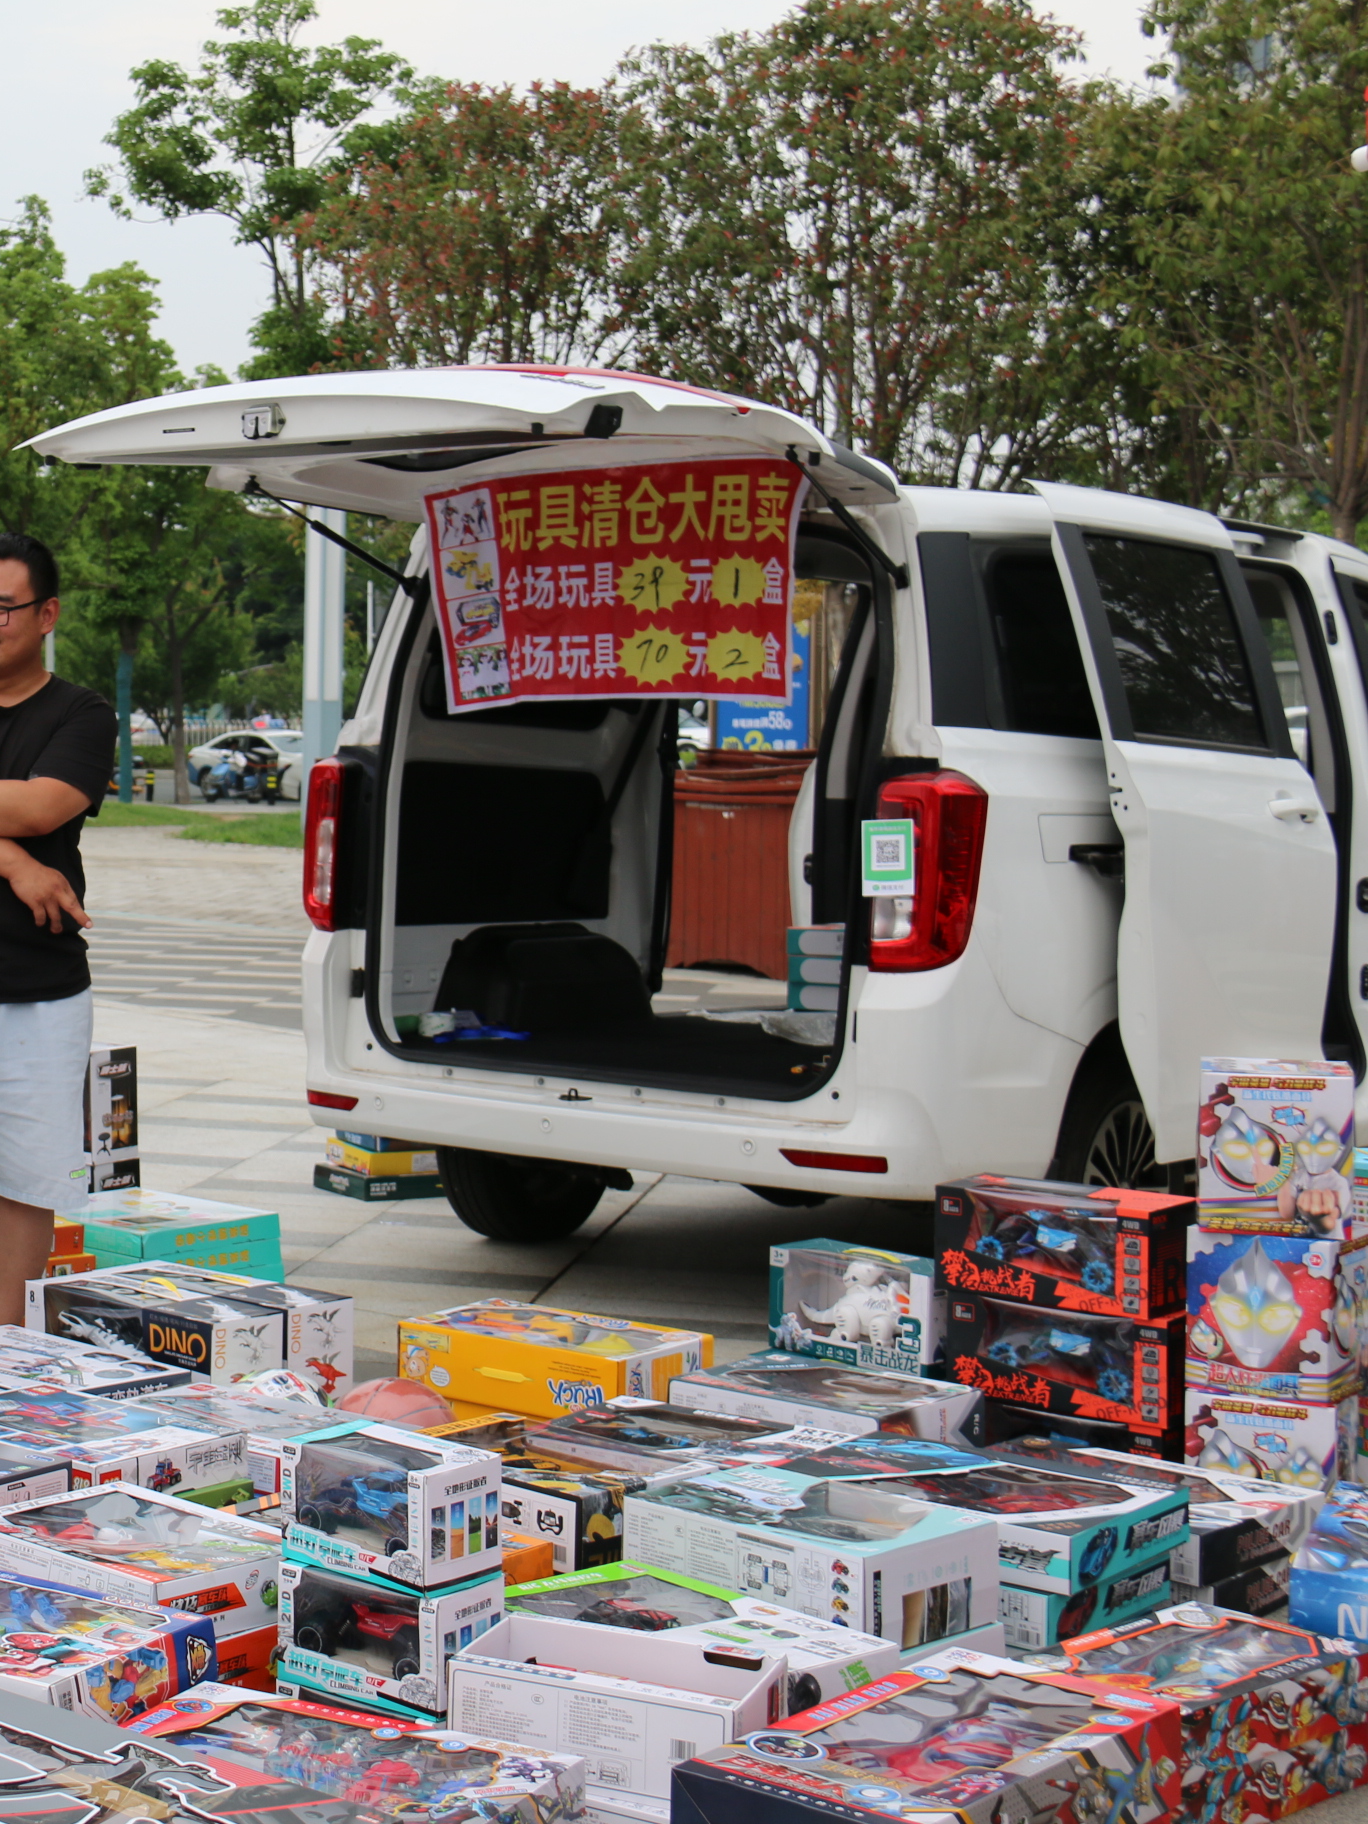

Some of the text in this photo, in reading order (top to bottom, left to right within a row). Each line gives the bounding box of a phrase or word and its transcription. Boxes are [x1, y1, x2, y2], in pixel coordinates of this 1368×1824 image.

[497, 472, 791, 553] 玩具清仓大甩卖
[1121, 1220, 1141, 1231] 4WD
[149, 1323, 207, 1364] DINO
[214, 1328, 226, 1370] DINO
[291, 1312, 302, 1354] DINO
[1138, 1328, 1159, 1338] 4WD
[859, 1343, 919, 1376] 暴击战龙
[282, 1467, 292, 1500] 2WD
[281, 1591, 291, 1622] 2WD
